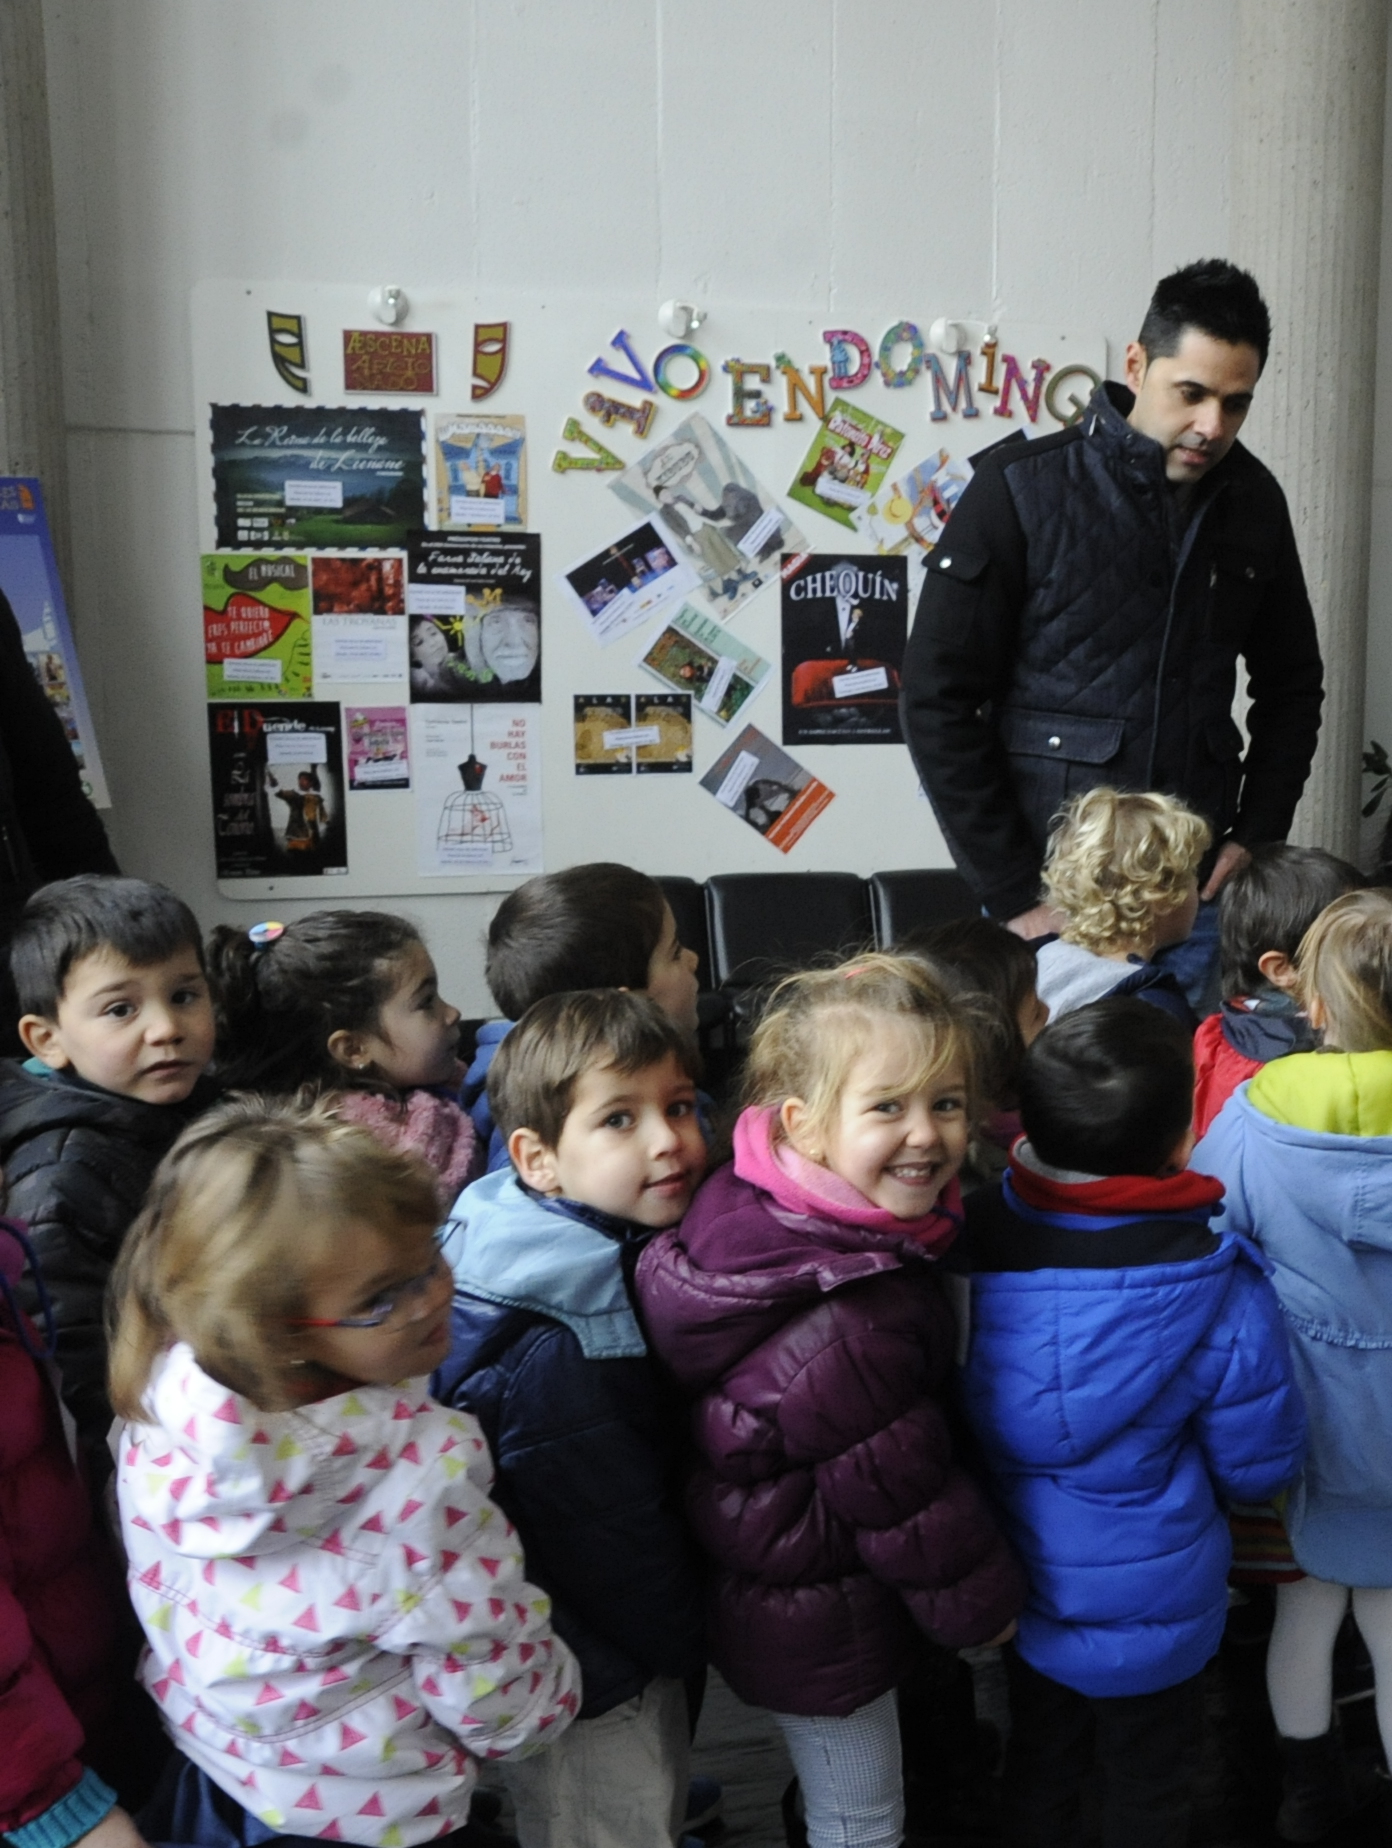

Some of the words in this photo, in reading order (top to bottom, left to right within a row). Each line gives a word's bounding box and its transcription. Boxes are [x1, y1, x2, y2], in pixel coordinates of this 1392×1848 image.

[722, 352, 828, 428] EN
[261, 564, 295, 578] MUSICAL
[789, 569, 899, 604] CHEQUÍN
[512, 719, 526, 728] NO
[507, 730, 526, 739] HAY
[489, 741, 527, 750] BURLAS
[507, 752, 527, 761] CON
[499, 774, 528, 783] AMOR
